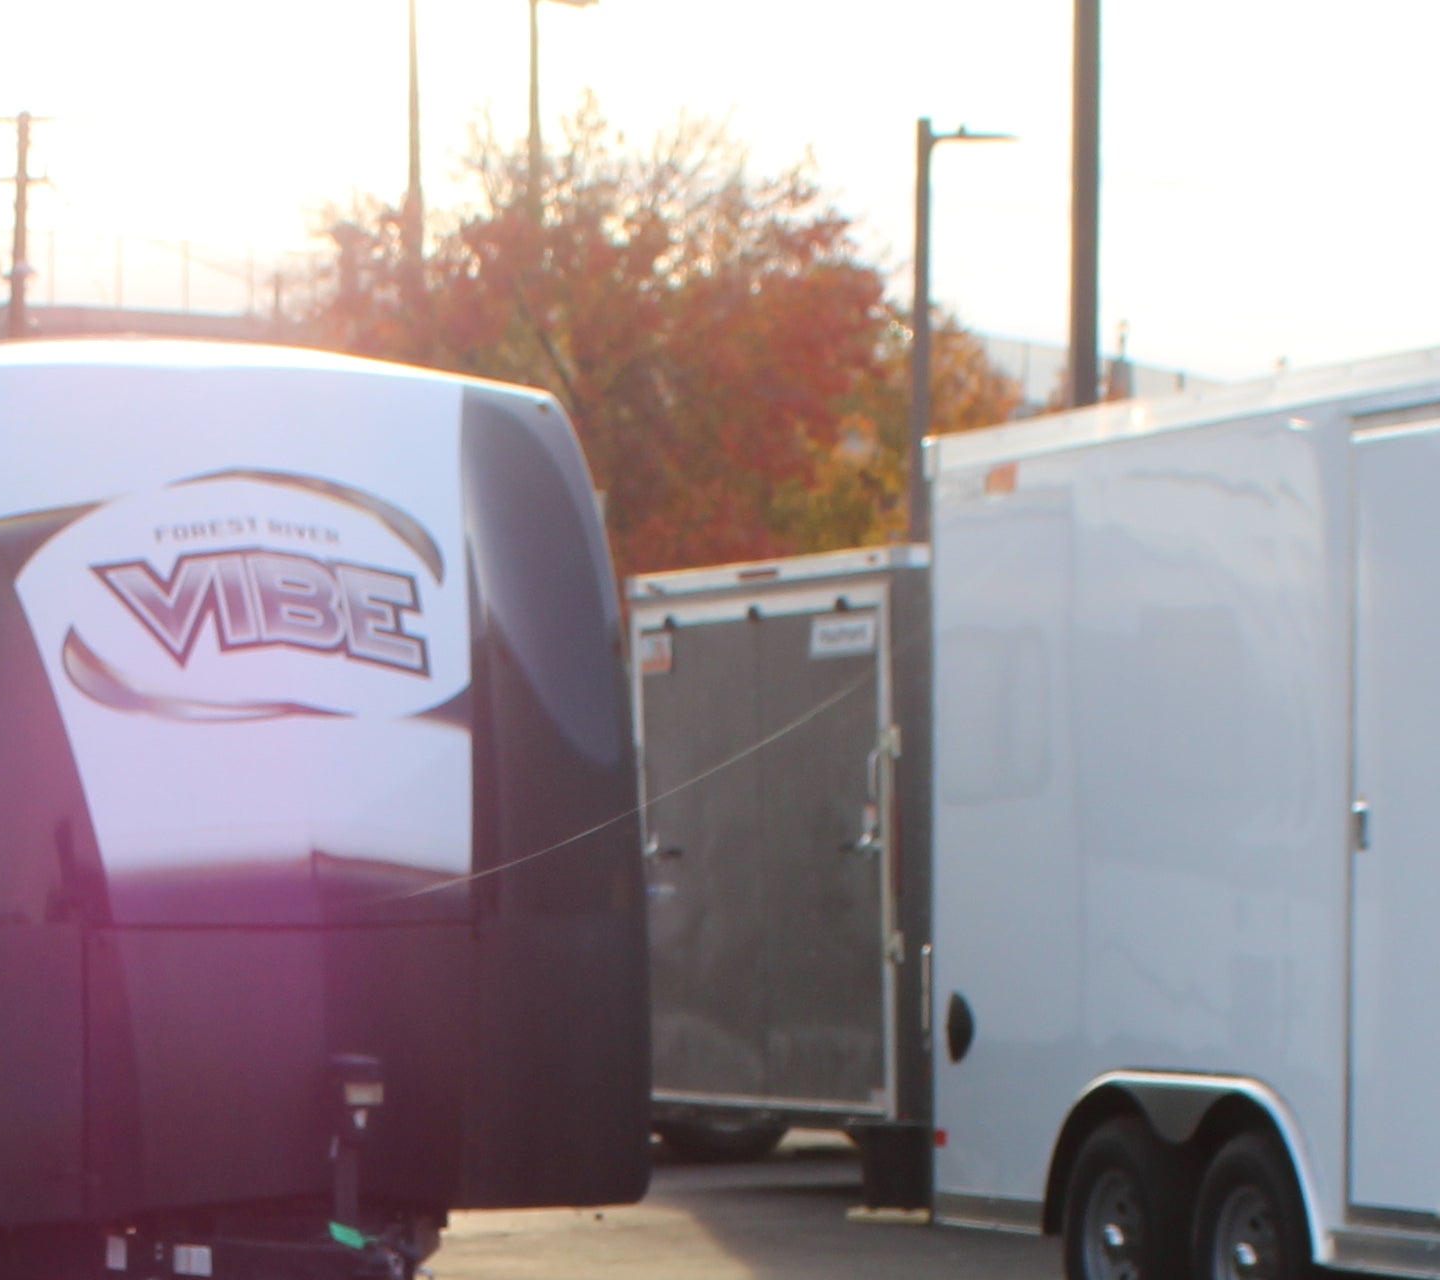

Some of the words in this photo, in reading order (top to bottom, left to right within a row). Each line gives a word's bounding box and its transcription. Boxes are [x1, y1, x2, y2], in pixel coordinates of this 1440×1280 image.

[154, 517, 258, 544] FOREST
[268, 518, 341, 544] RIVER
[88, 545, 432, 680] VIBE
